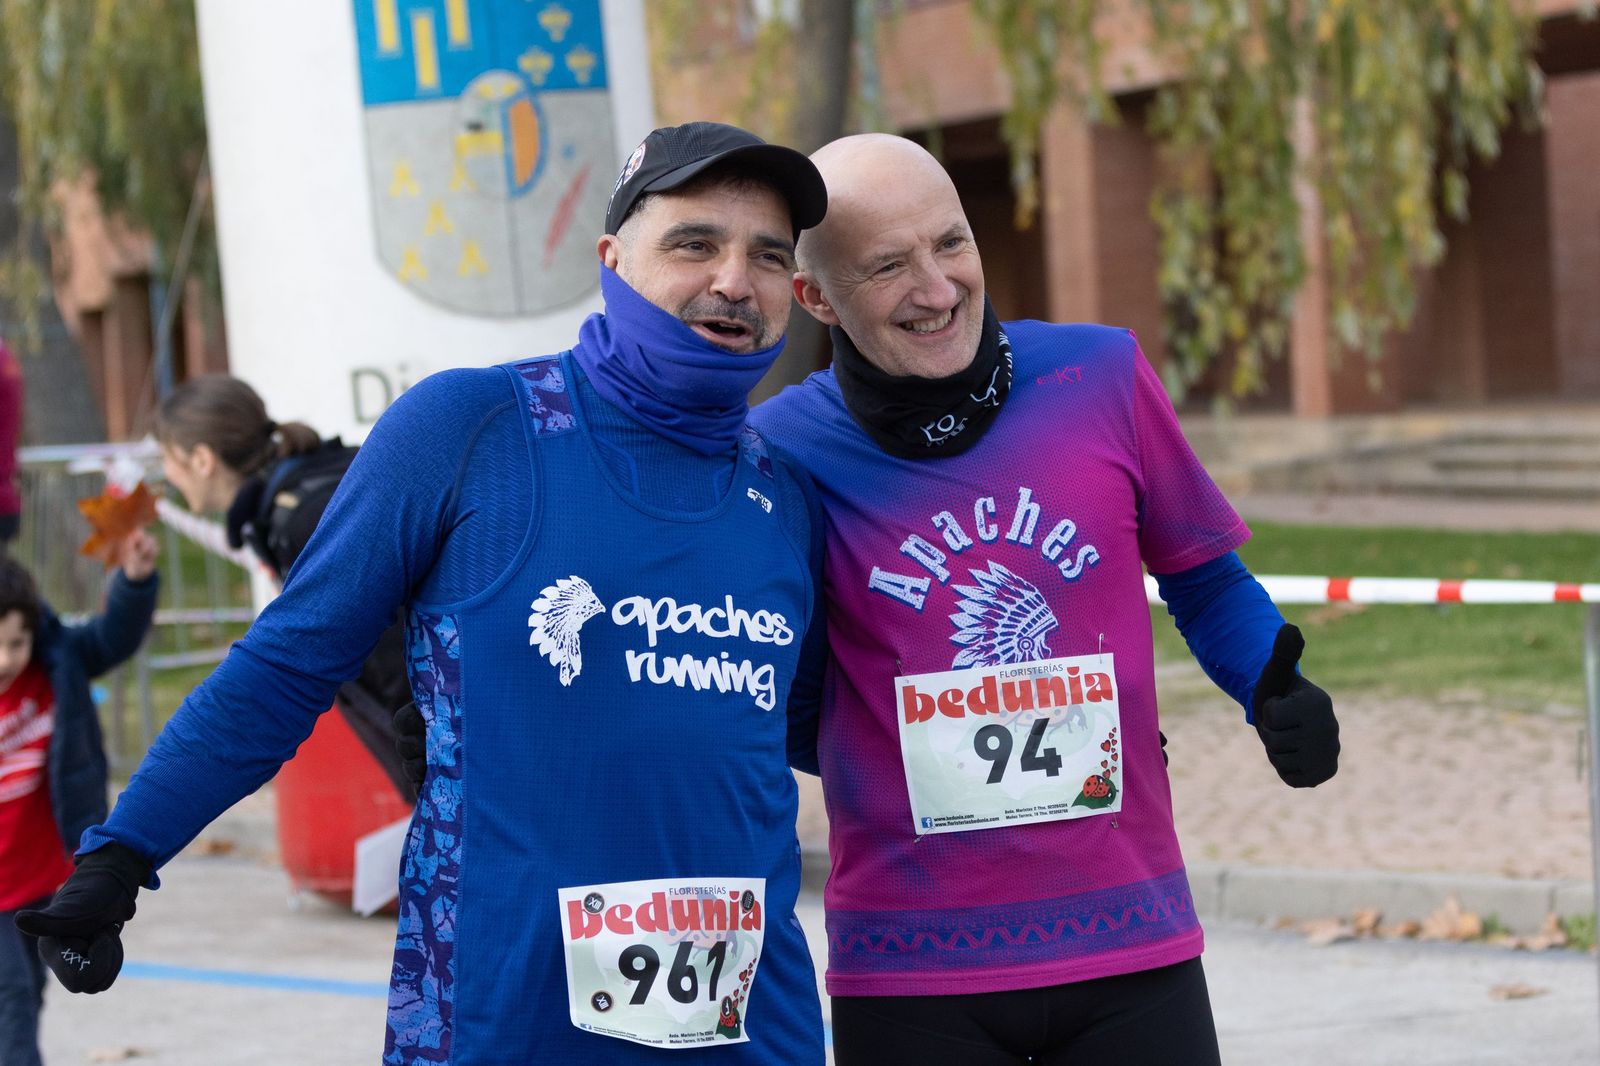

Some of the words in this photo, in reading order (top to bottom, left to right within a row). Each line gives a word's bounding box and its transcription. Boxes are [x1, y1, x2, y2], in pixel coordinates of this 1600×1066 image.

[868, 486, 1100, 614] Apaches
[611, 594, 794, 647] apaches
[625, 650, 776, 711] running
[902, 666, 1113, 724] bedunia
[999, 664, 1064, 679] FLORISTERÍAS
[973, 718, 1063, 784] 94
[567, 890, 762, 941] bedunia
[669, 885, 727, 896] FLORISTERÍAS
[618, 940, 727, 1006] 961
